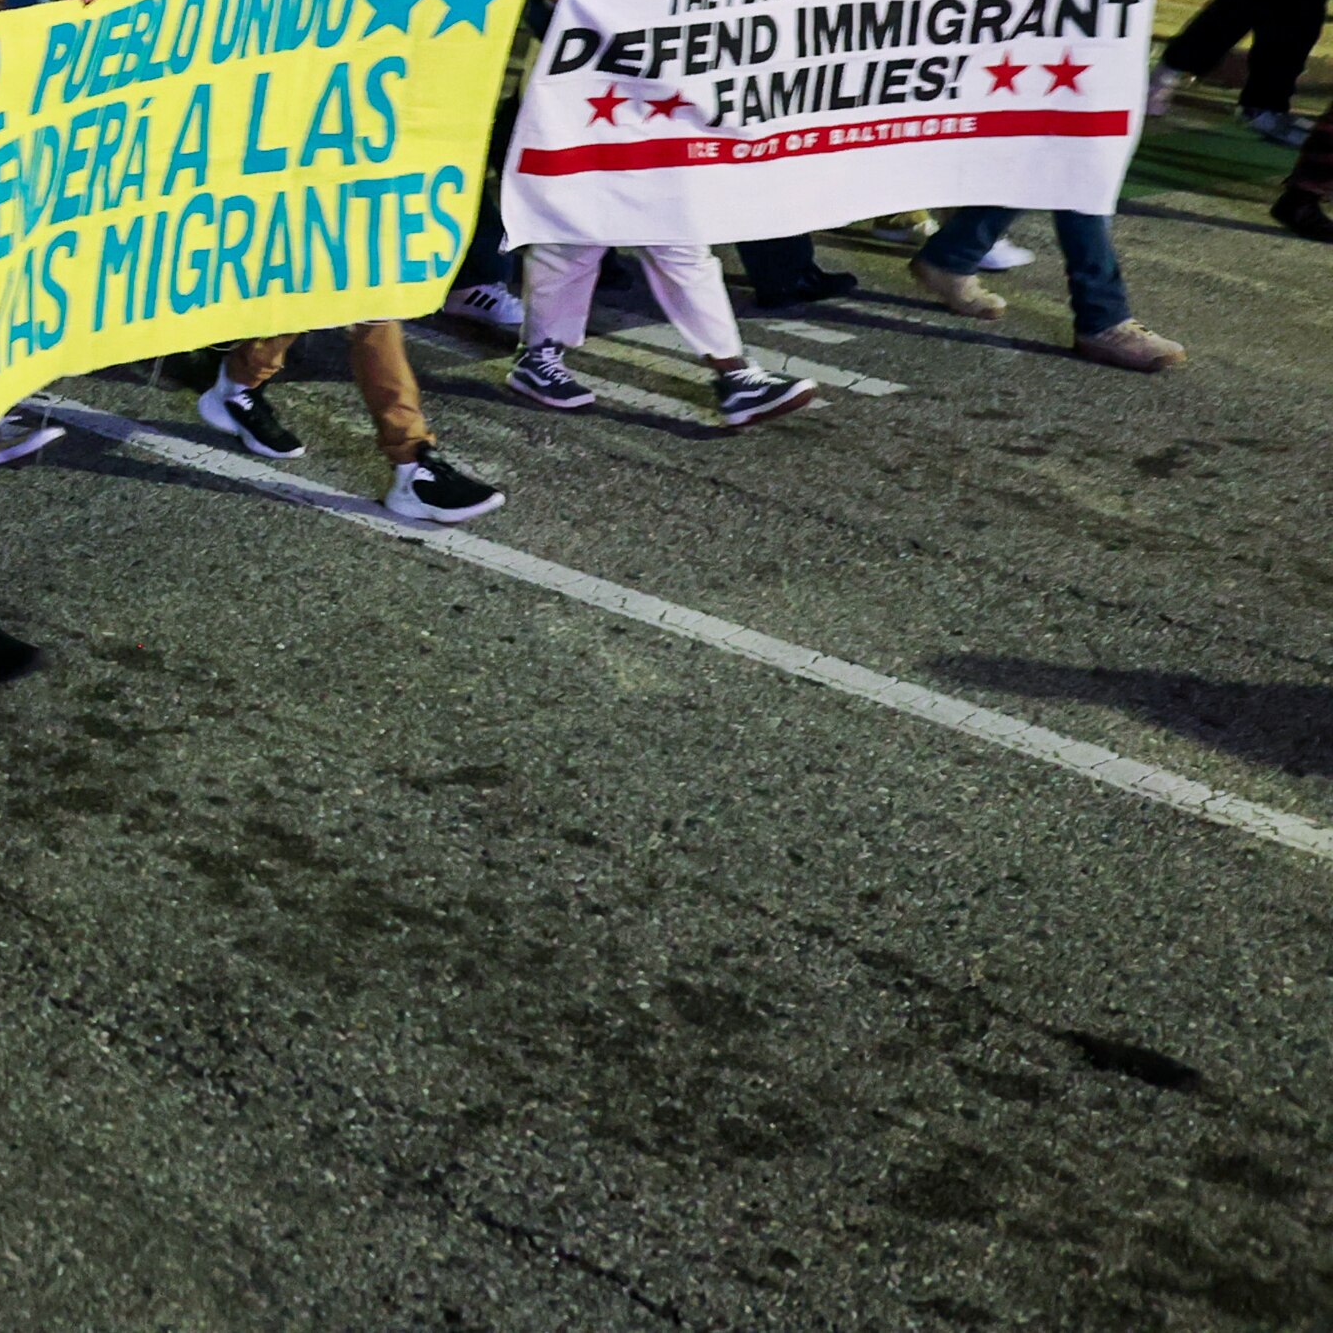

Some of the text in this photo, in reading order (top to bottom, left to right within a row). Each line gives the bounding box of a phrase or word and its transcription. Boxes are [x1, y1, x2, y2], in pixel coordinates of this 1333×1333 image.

[547, 13, 779, 79] DEFEND
[163, 83, 212, 196] A
[243, 55, 408, 177] LAS
[705, 55, 968, 129] FAMILIES!
[686, 115, 978, 160] ICE OUT OF BALTIMORE
[92, 164, 466, 332] MIGRANTES
